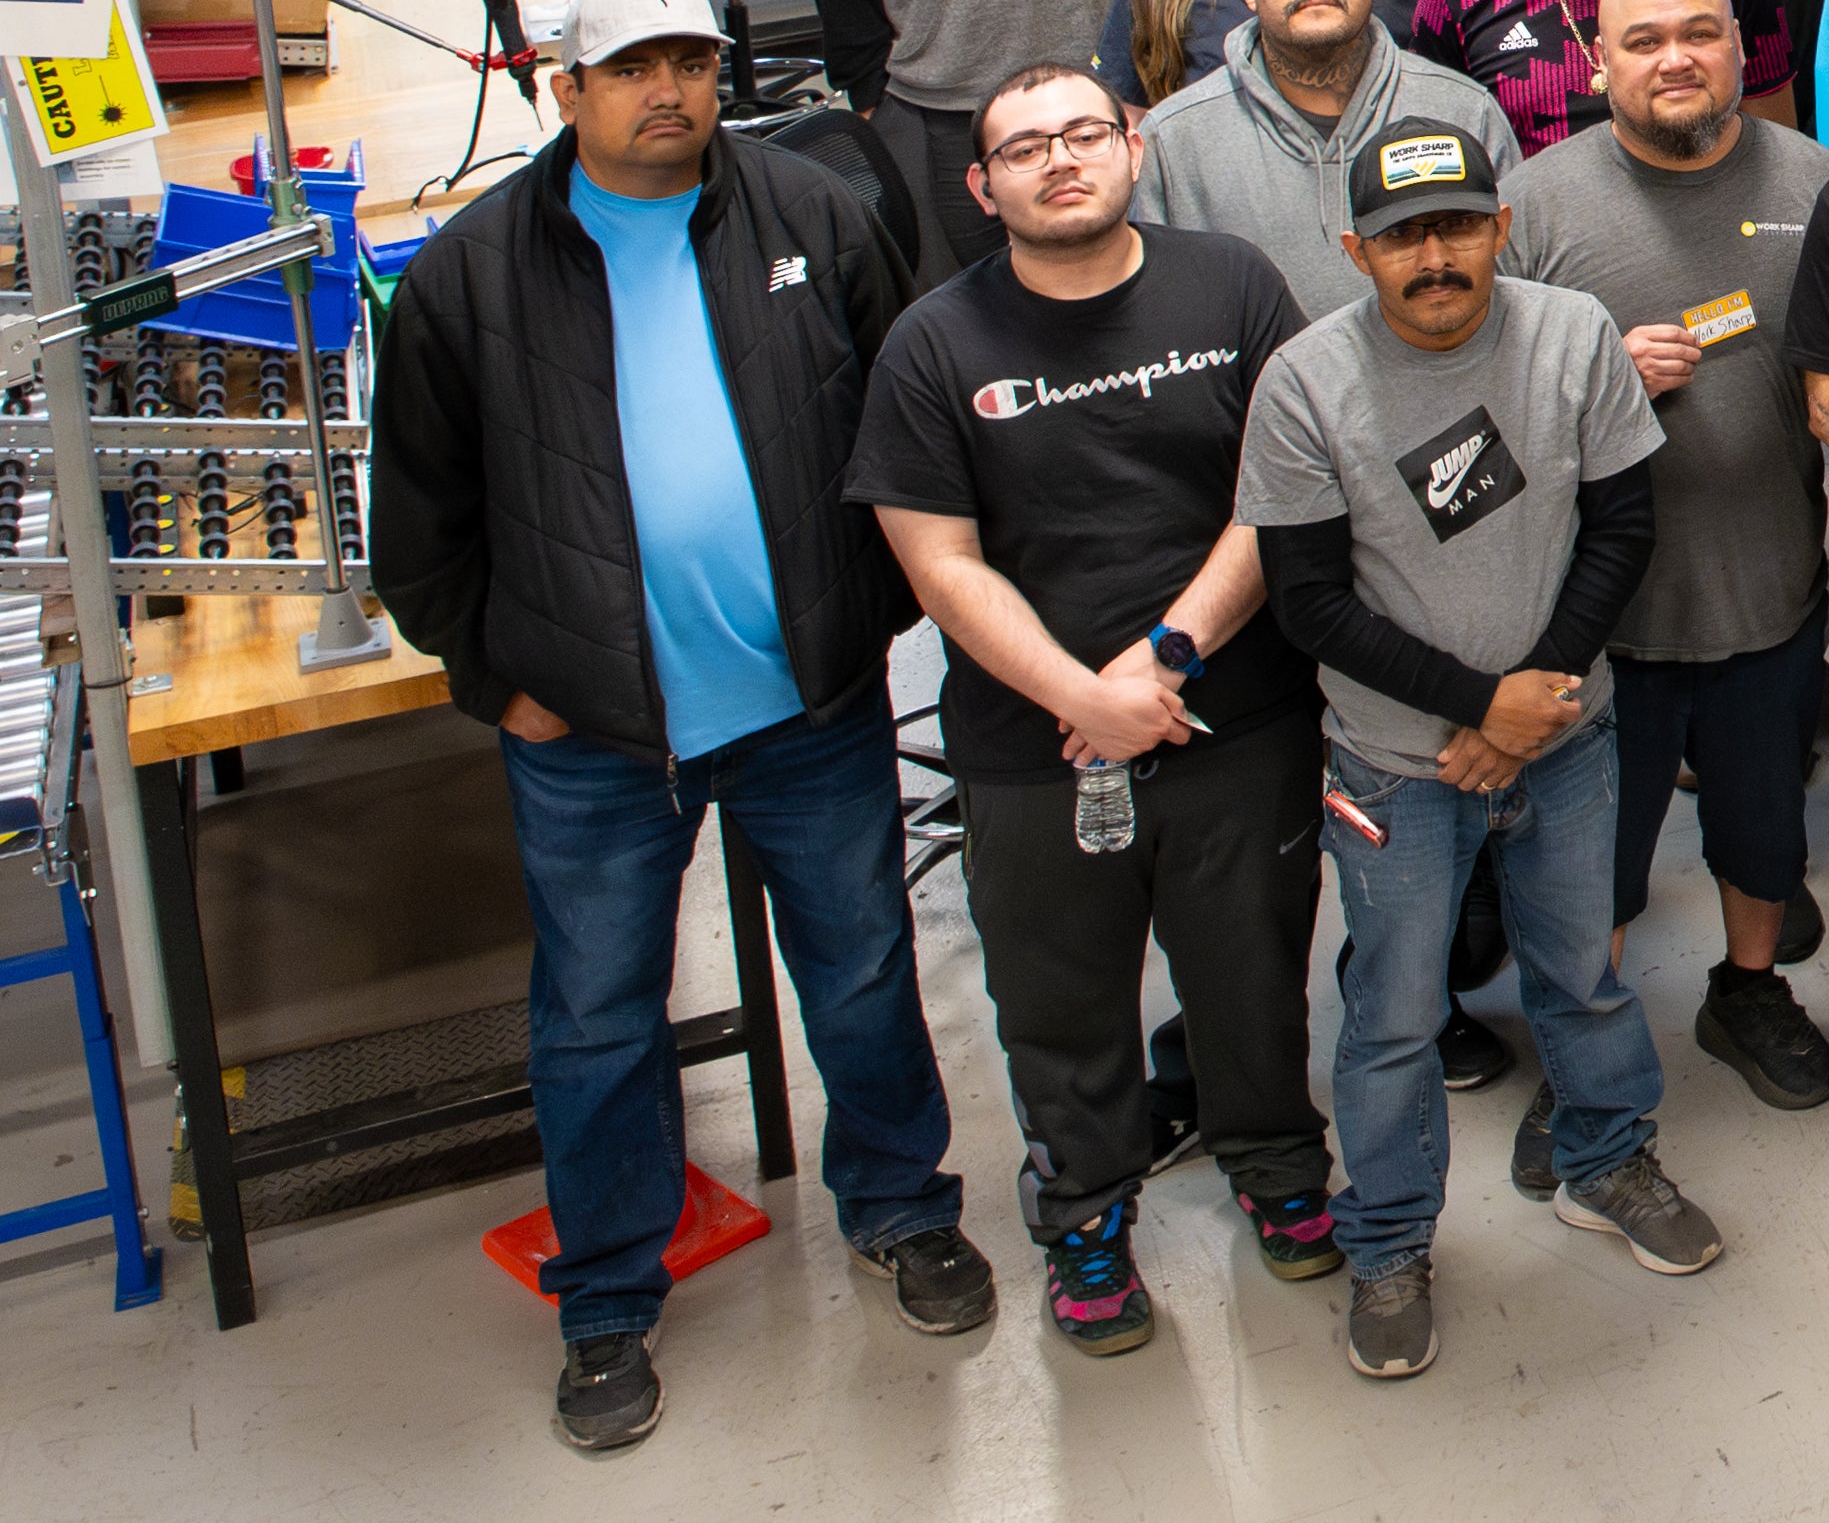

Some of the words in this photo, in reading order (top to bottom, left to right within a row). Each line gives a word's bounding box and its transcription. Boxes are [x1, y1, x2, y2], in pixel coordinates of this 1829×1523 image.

[1499, 38, 1539, 50] adidas
[31, 57, 77, 139] CAUT
[1389, 145, 1418, 159] WORK
[1421, 142, 1454, 152] SHARP
[1756, 222, 1780, 231] WORK
[1780, 223, 1804, 232] SHARP
[1690, 302, 1725, 324] HELLO
[1727, 296, 1744, 313] I'M
[1717, 313, 1753, 337] Sharp
[973, 348, 1238, 420] Champion
[1430, 434, 1483, 488] JUMP
[1448, 474, 1496, 516] MAN
